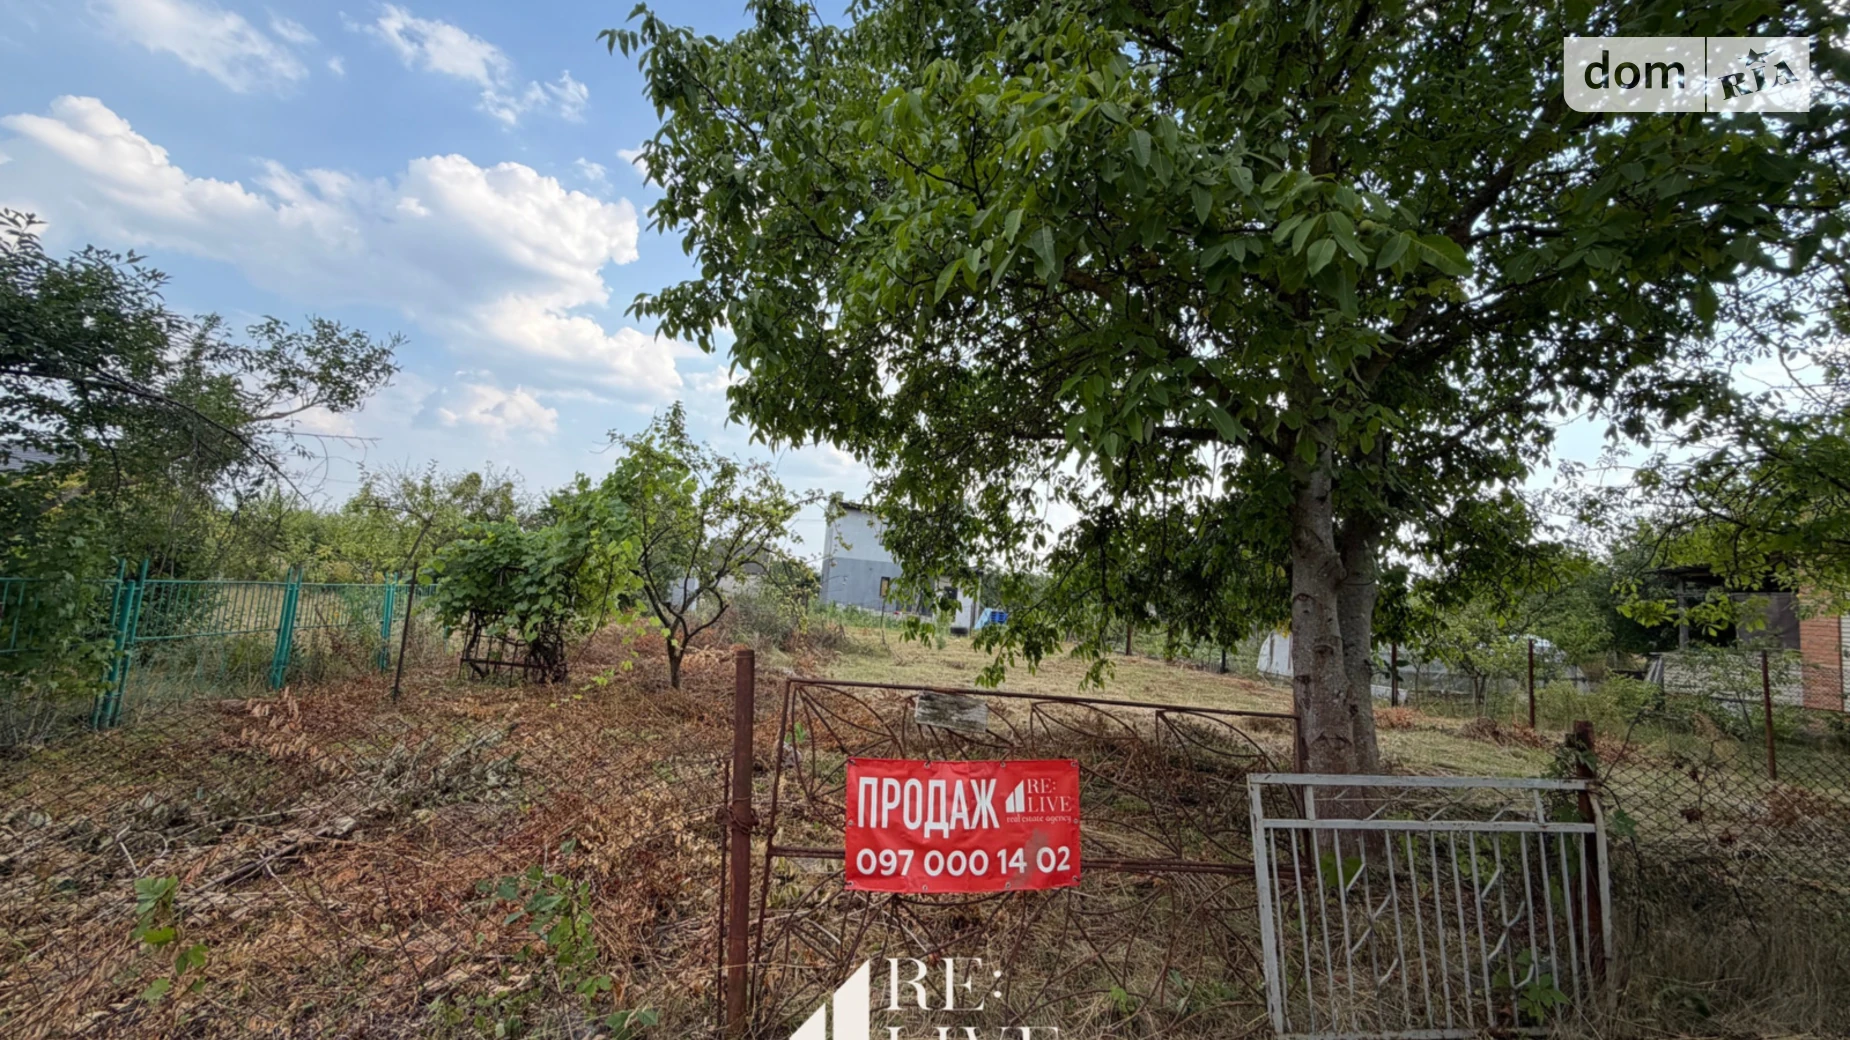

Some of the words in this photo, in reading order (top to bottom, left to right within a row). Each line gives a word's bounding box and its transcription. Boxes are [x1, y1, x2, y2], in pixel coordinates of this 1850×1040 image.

[1027, 778, 1057, 794] RE:
[857, 777, 1000, 839] ПРОДАЖ
[1027, 796, 1072, 813] LIVE
[1006, 814, 1021, 823] real
[1021, 815, 1044, 823] estate
[1045, 815, 1072, 825] agency
[856, 848, 914, 876] 097
[923, 849, 989, 877] 000
[997, 847, 1027, 875] 14
[1036, 846, 1071, 873] 02
